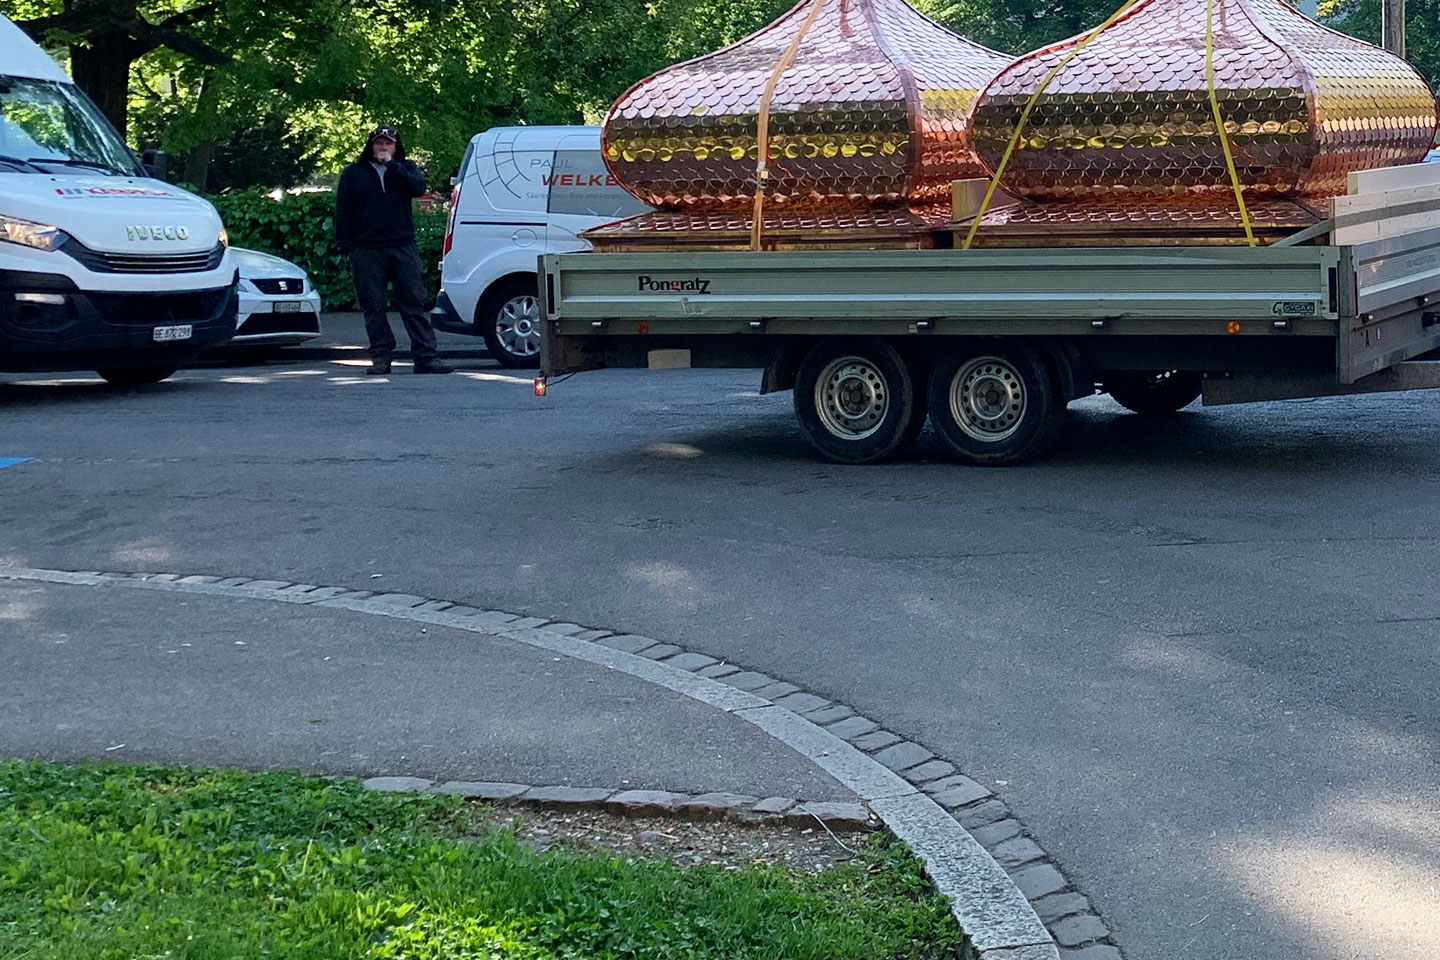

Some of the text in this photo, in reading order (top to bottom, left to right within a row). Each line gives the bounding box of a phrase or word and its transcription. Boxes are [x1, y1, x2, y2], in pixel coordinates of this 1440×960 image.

[530, 157, 574, 169] PAUL
[126, 225, 190, 241] IVECO
[638, 275, 711, 295] Pongratz
